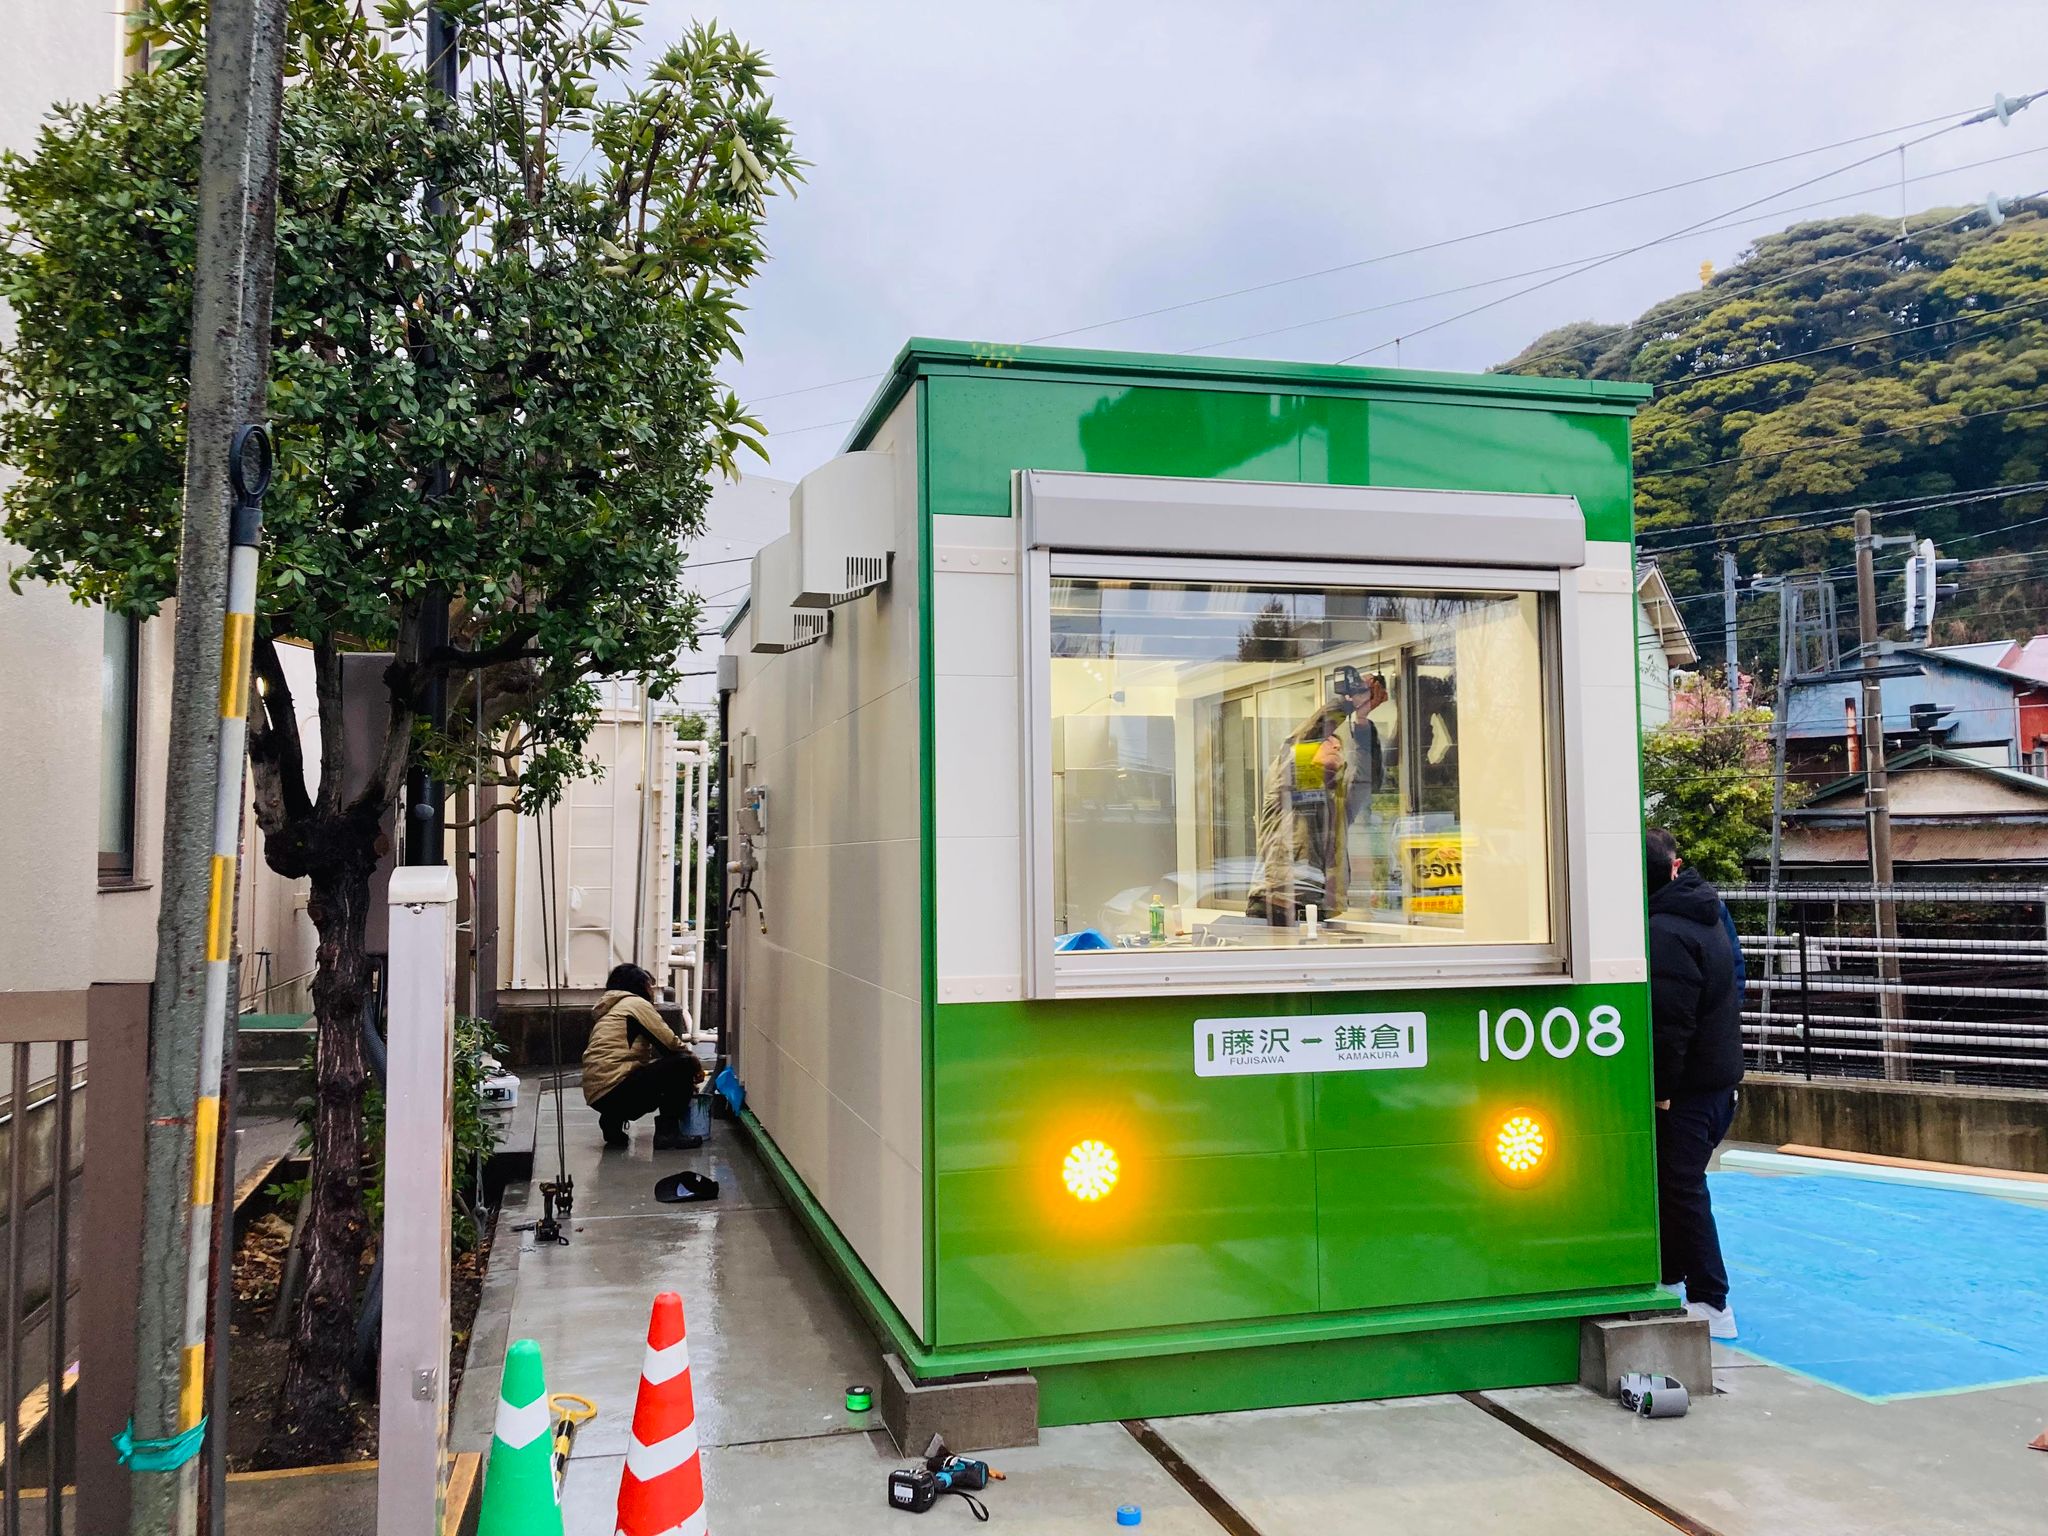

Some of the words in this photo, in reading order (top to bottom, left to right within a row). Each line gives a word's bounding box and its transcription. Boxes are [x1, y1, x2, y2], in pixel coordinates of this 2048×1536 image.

[1221, 1028, 1290, 1056] 藤沢
[1334, 1023, 1401, 1051] 鎌倉
[1478, 1005, 1625, 1062] 1008
[1229, 1055, 1285, 1066] FUJISAWA
[1338, 1051, 1400, 1061] KAMAKURA
